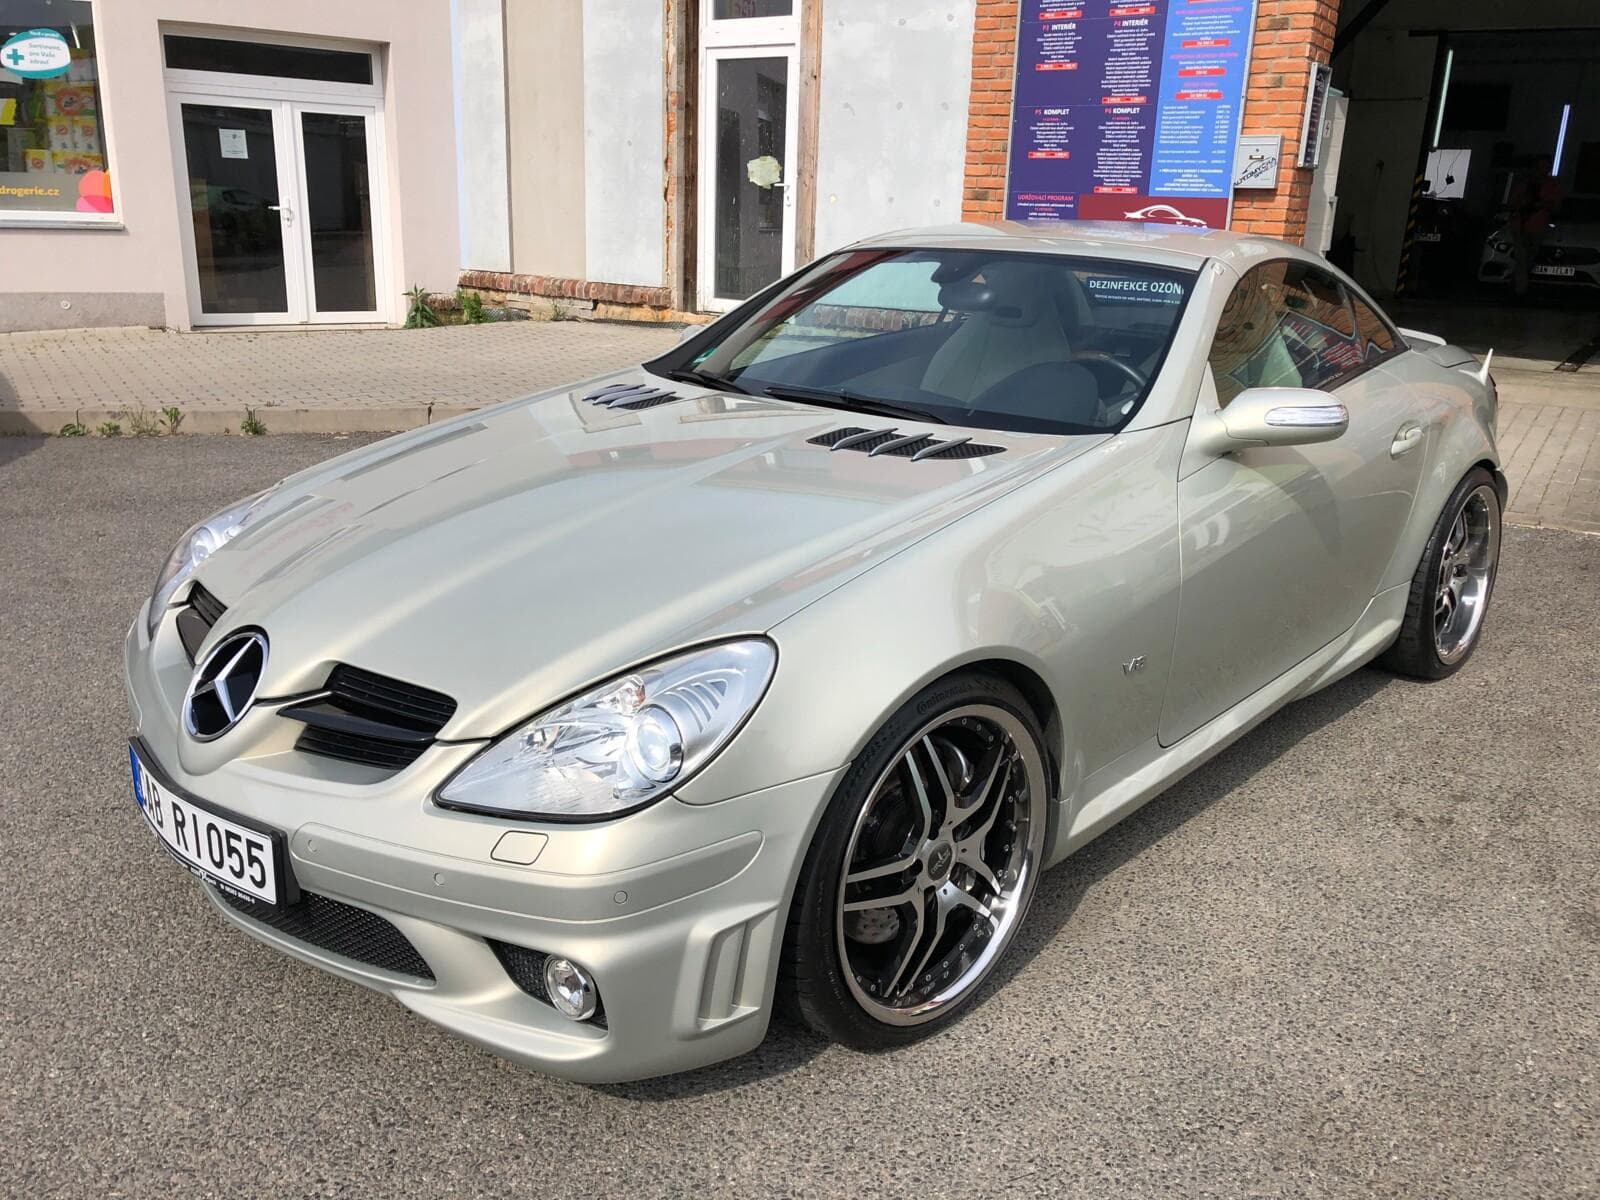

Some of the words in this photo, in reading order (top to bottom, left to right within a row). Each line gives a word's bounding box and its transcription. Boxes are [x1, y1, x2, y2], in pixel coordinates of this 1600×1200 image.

[1051, 22, 1077, 31] INTERIÉR
[1122, 18, 1149, 27] INTERIÉR
[0, 185, 60, 197] drogerie.cz
[1089, 280, 1148, 291] DEZINFEKCE
